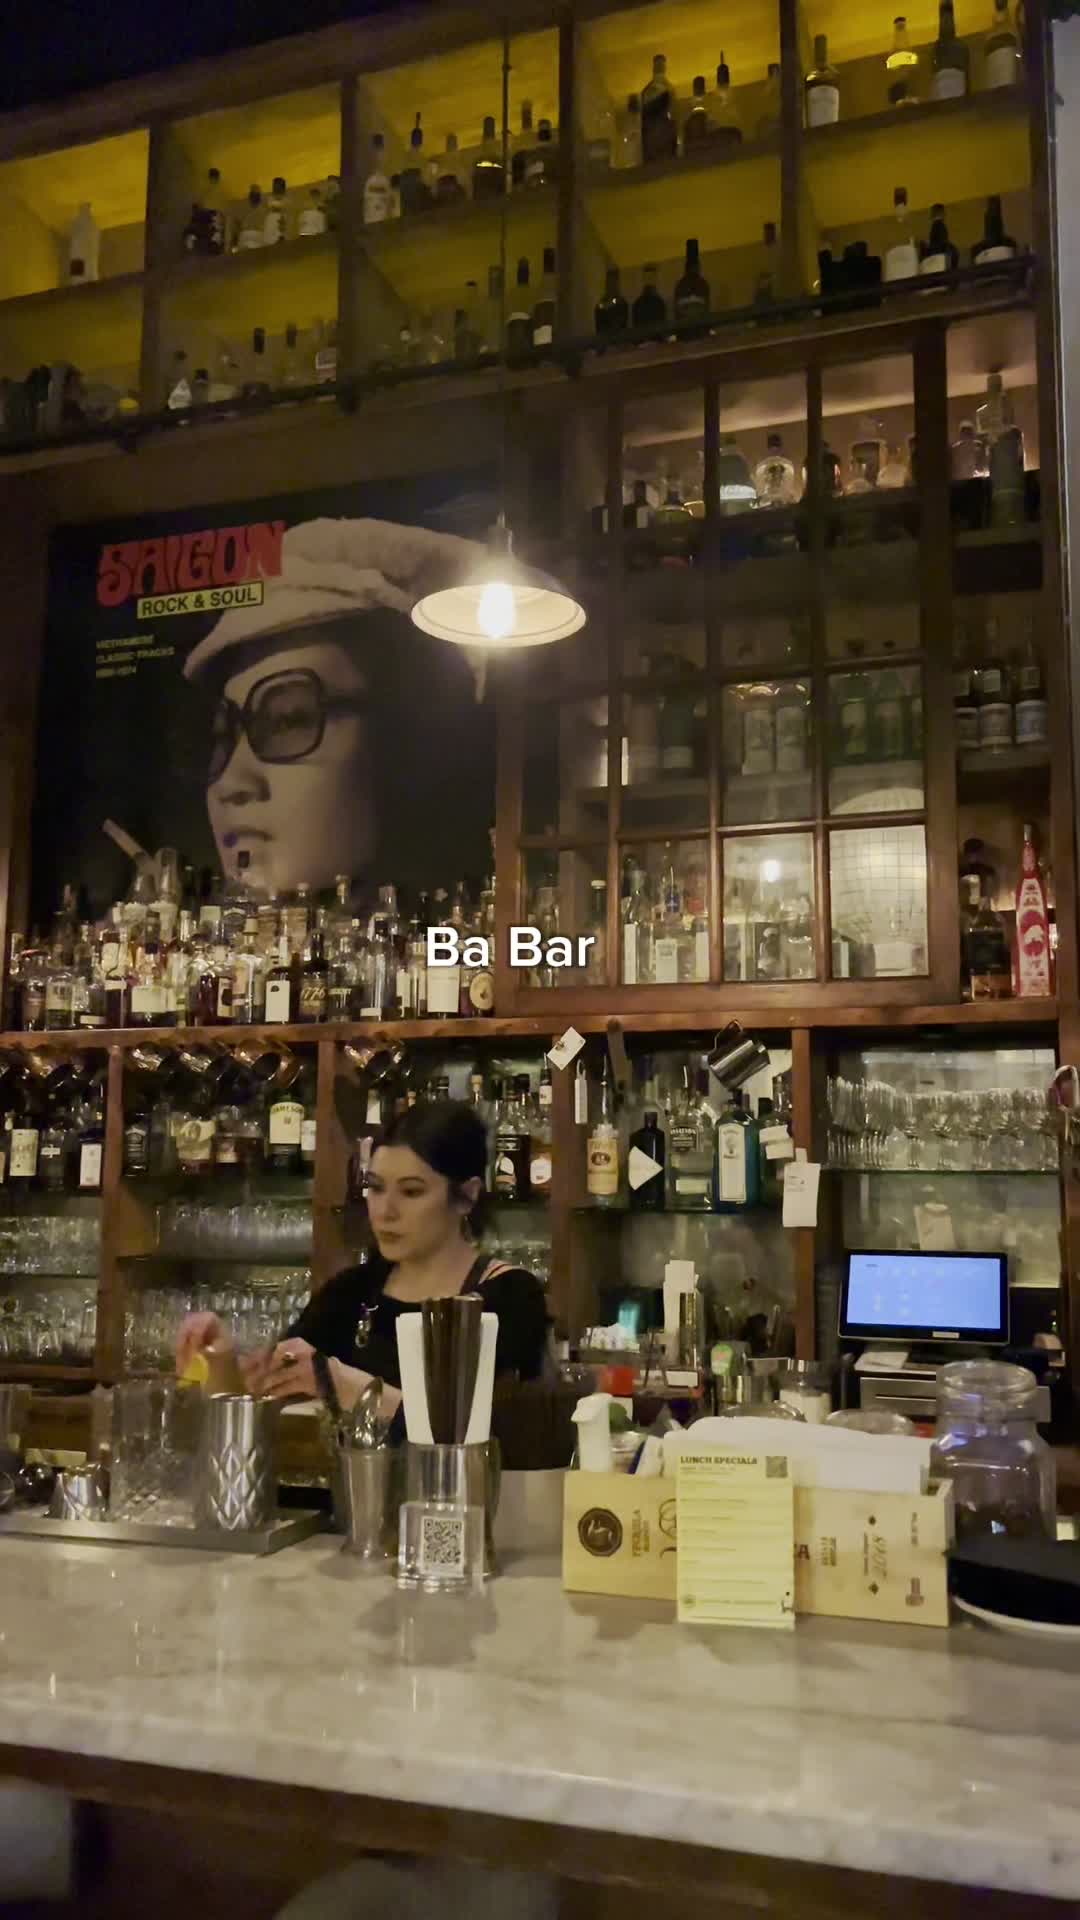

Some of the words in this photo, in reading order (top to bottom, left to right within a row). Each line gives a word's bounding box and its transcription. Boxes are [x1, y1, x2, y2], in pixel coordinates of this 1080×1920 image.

[97, 520, 287, 607] SAIGON
[142, 596, 188, 616] ROCK
[193, 594, 205, 609] &
[210, 586, 257, 607] SOUL
[680, 1455, 712, 1465] LUNCH
[714, 1456, 758, 1465] SPECIALS
